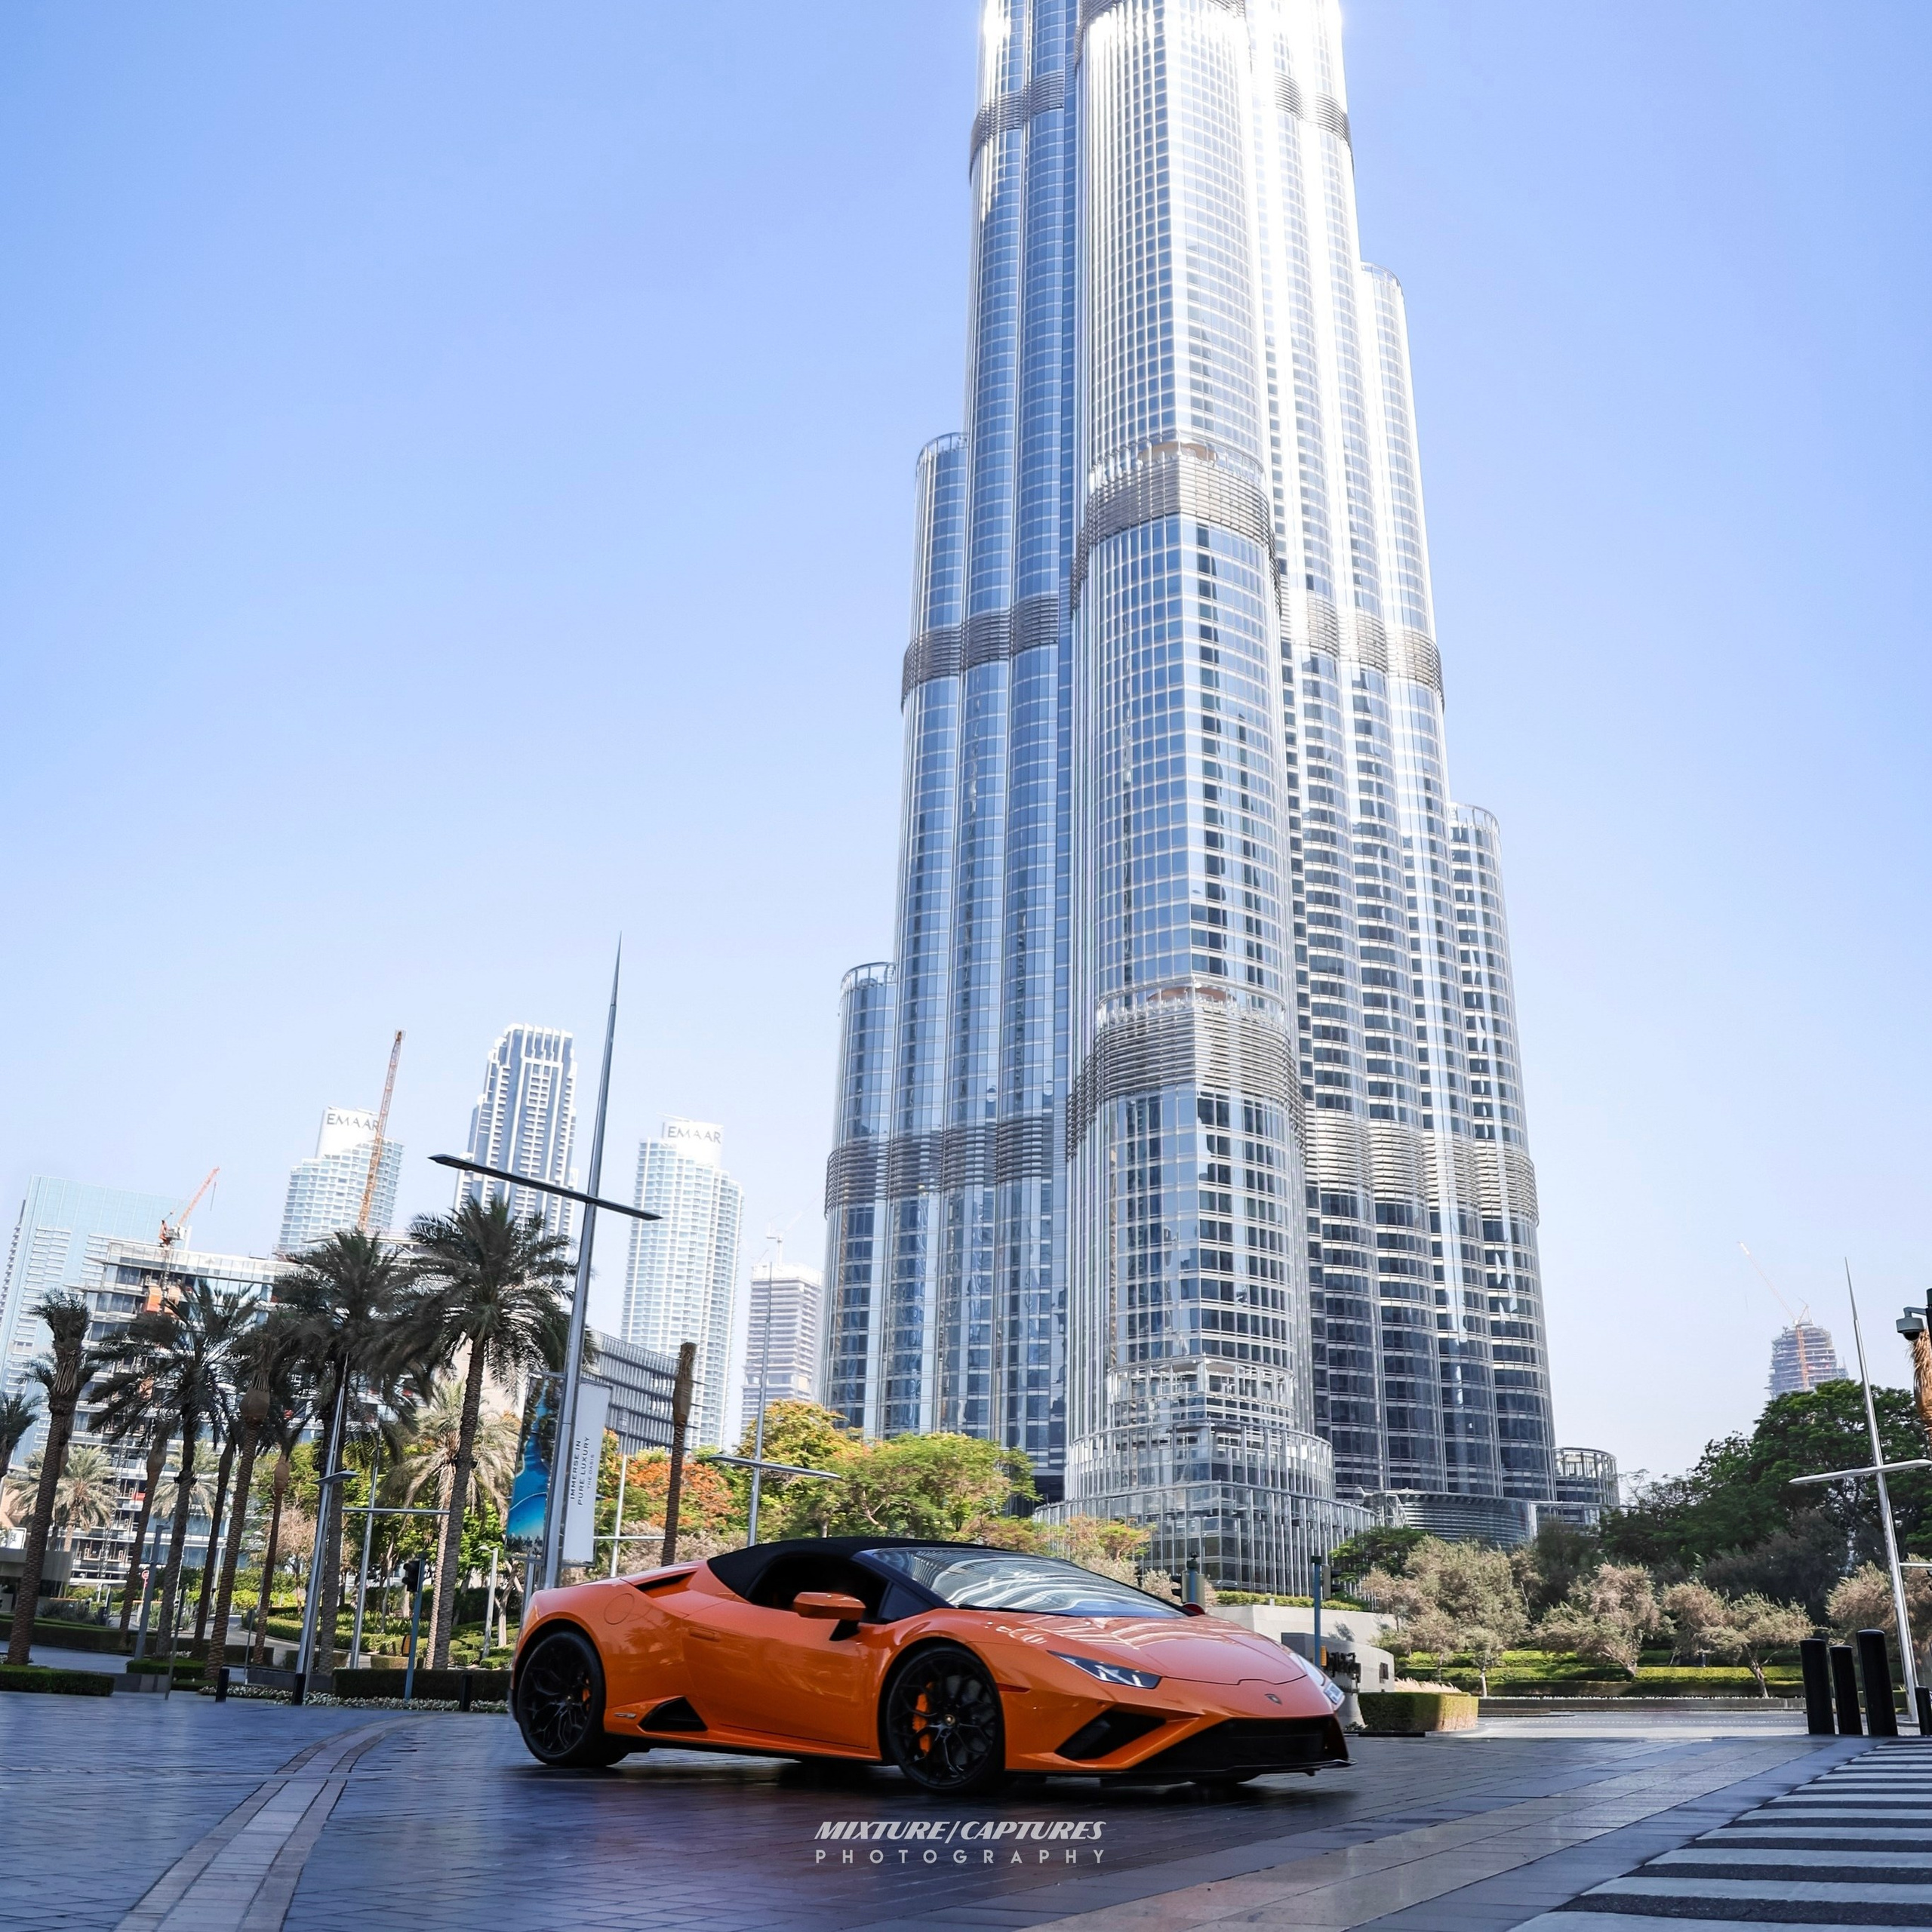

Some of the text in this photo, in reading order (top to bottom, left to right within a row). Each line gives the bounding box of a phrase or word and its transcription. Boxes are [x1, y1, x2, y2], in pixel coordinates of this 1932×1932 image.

[327, 1113, 379, 1131] EMAAR
[668, 1126, 721, 1144] EMAAR
[571, 1440, 581, 1499] IMMERSE IN
[580, 1437, 589, 1475] LUXURY
